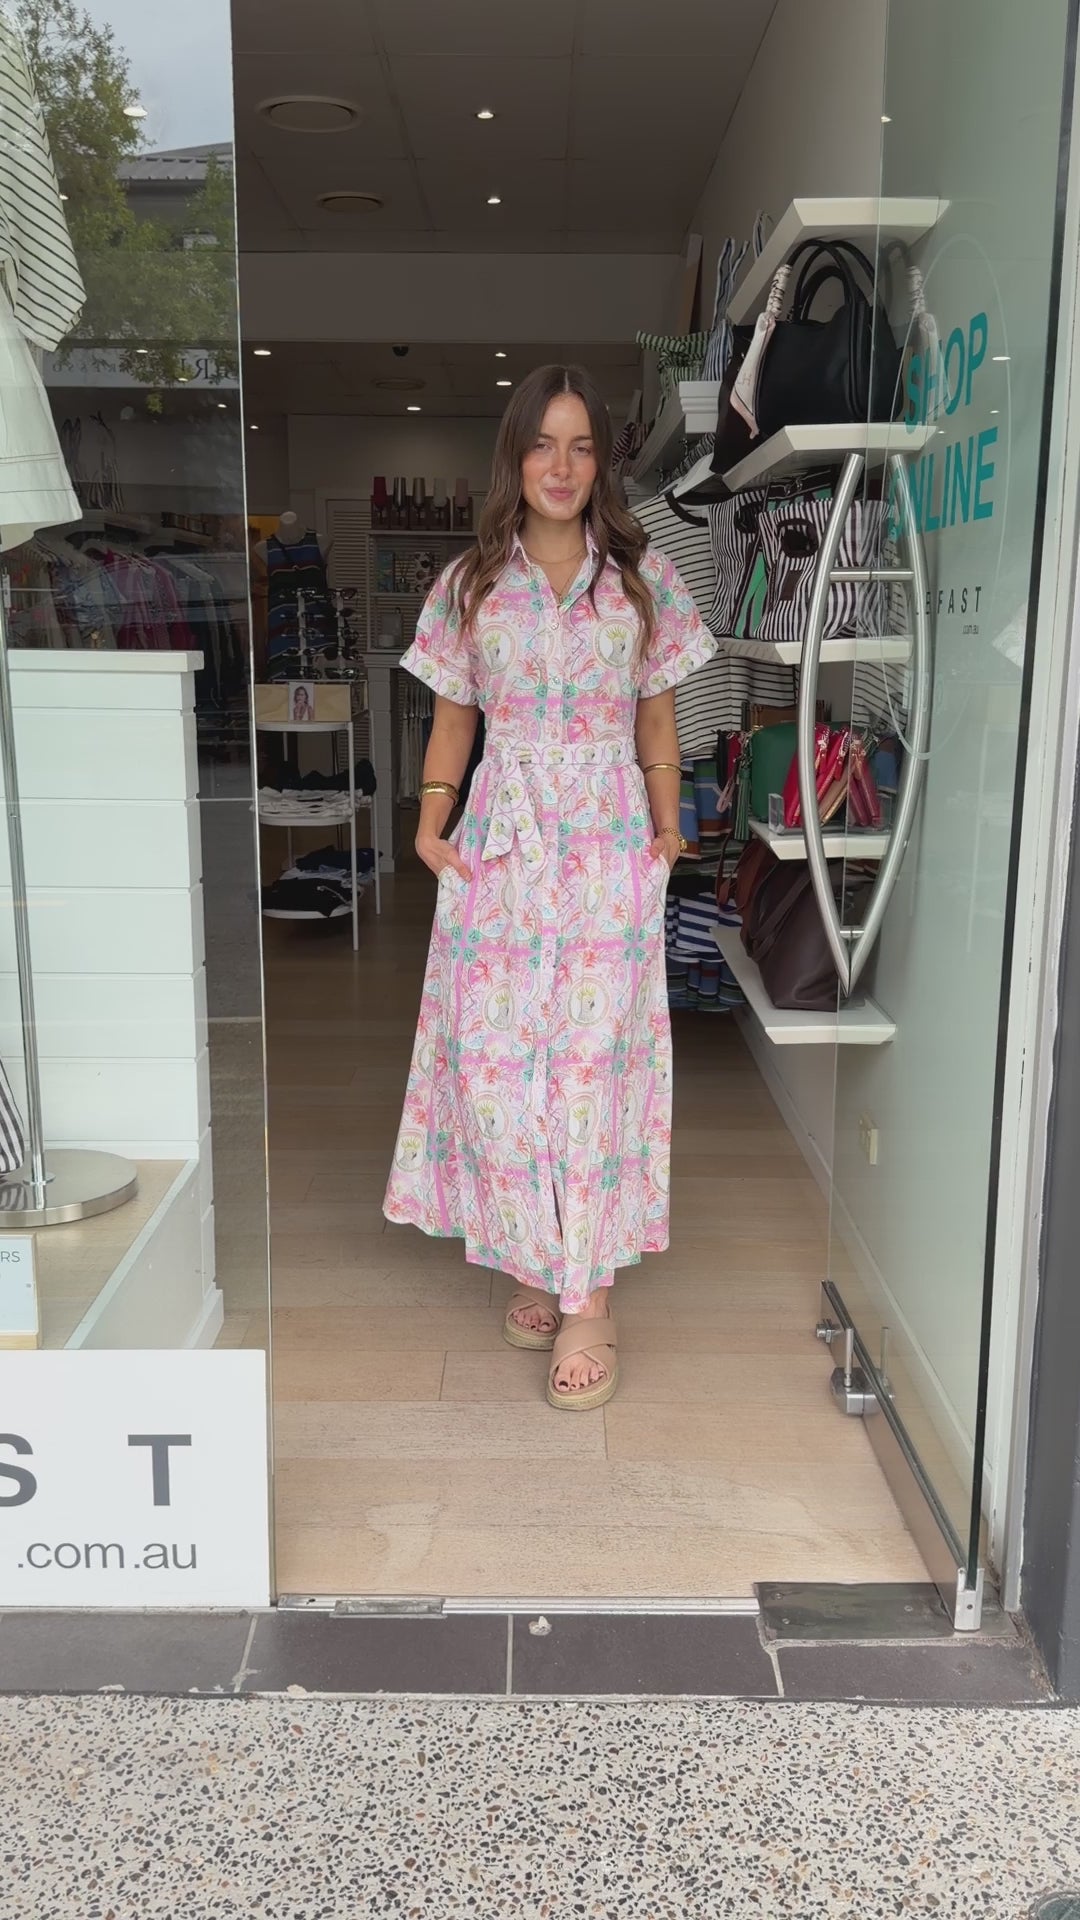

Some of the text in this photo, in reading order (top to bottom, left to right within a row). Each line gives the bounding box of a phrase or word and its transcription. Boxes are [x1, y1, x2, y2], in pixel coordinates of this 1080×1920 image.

[904, 311, 988, 434] SHOP
[887, 426, 998, 543] ONLINE
[916, 586, 982, 615] EFAST
[18, 1542, 197, 1569] .com.au
